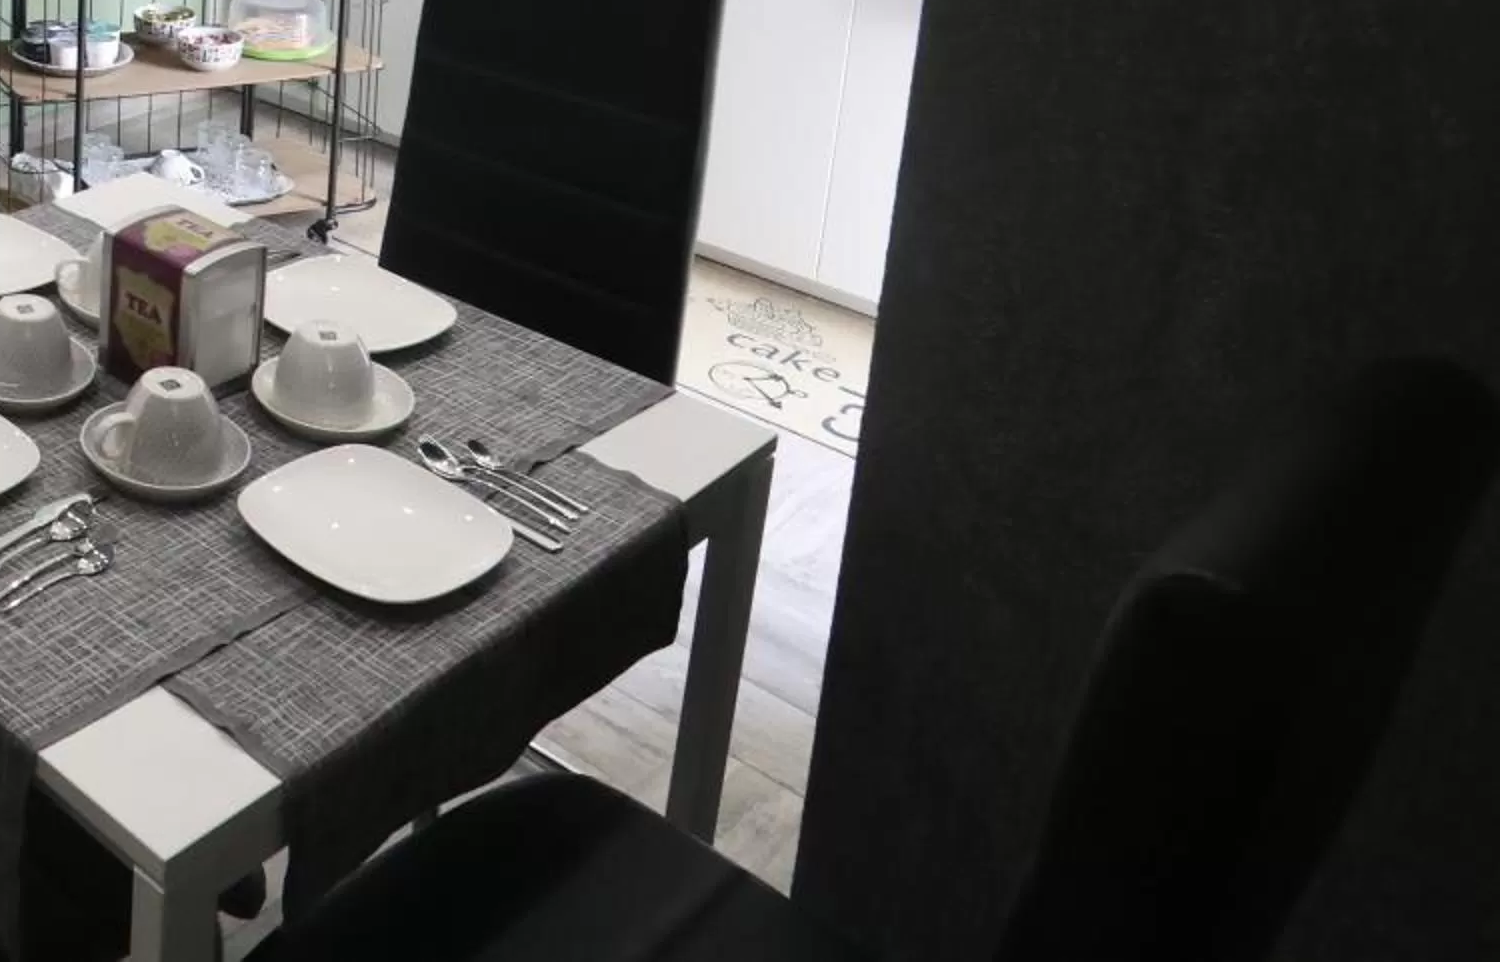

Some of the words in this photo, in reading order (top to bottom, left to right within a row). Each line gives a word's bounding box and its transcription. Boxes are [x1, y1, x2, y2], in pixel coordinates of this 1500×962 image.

[176, 218, 214, 239] TEA
[124, 290, 163, 325] TEA
[726, 331, 841, 383] cake
